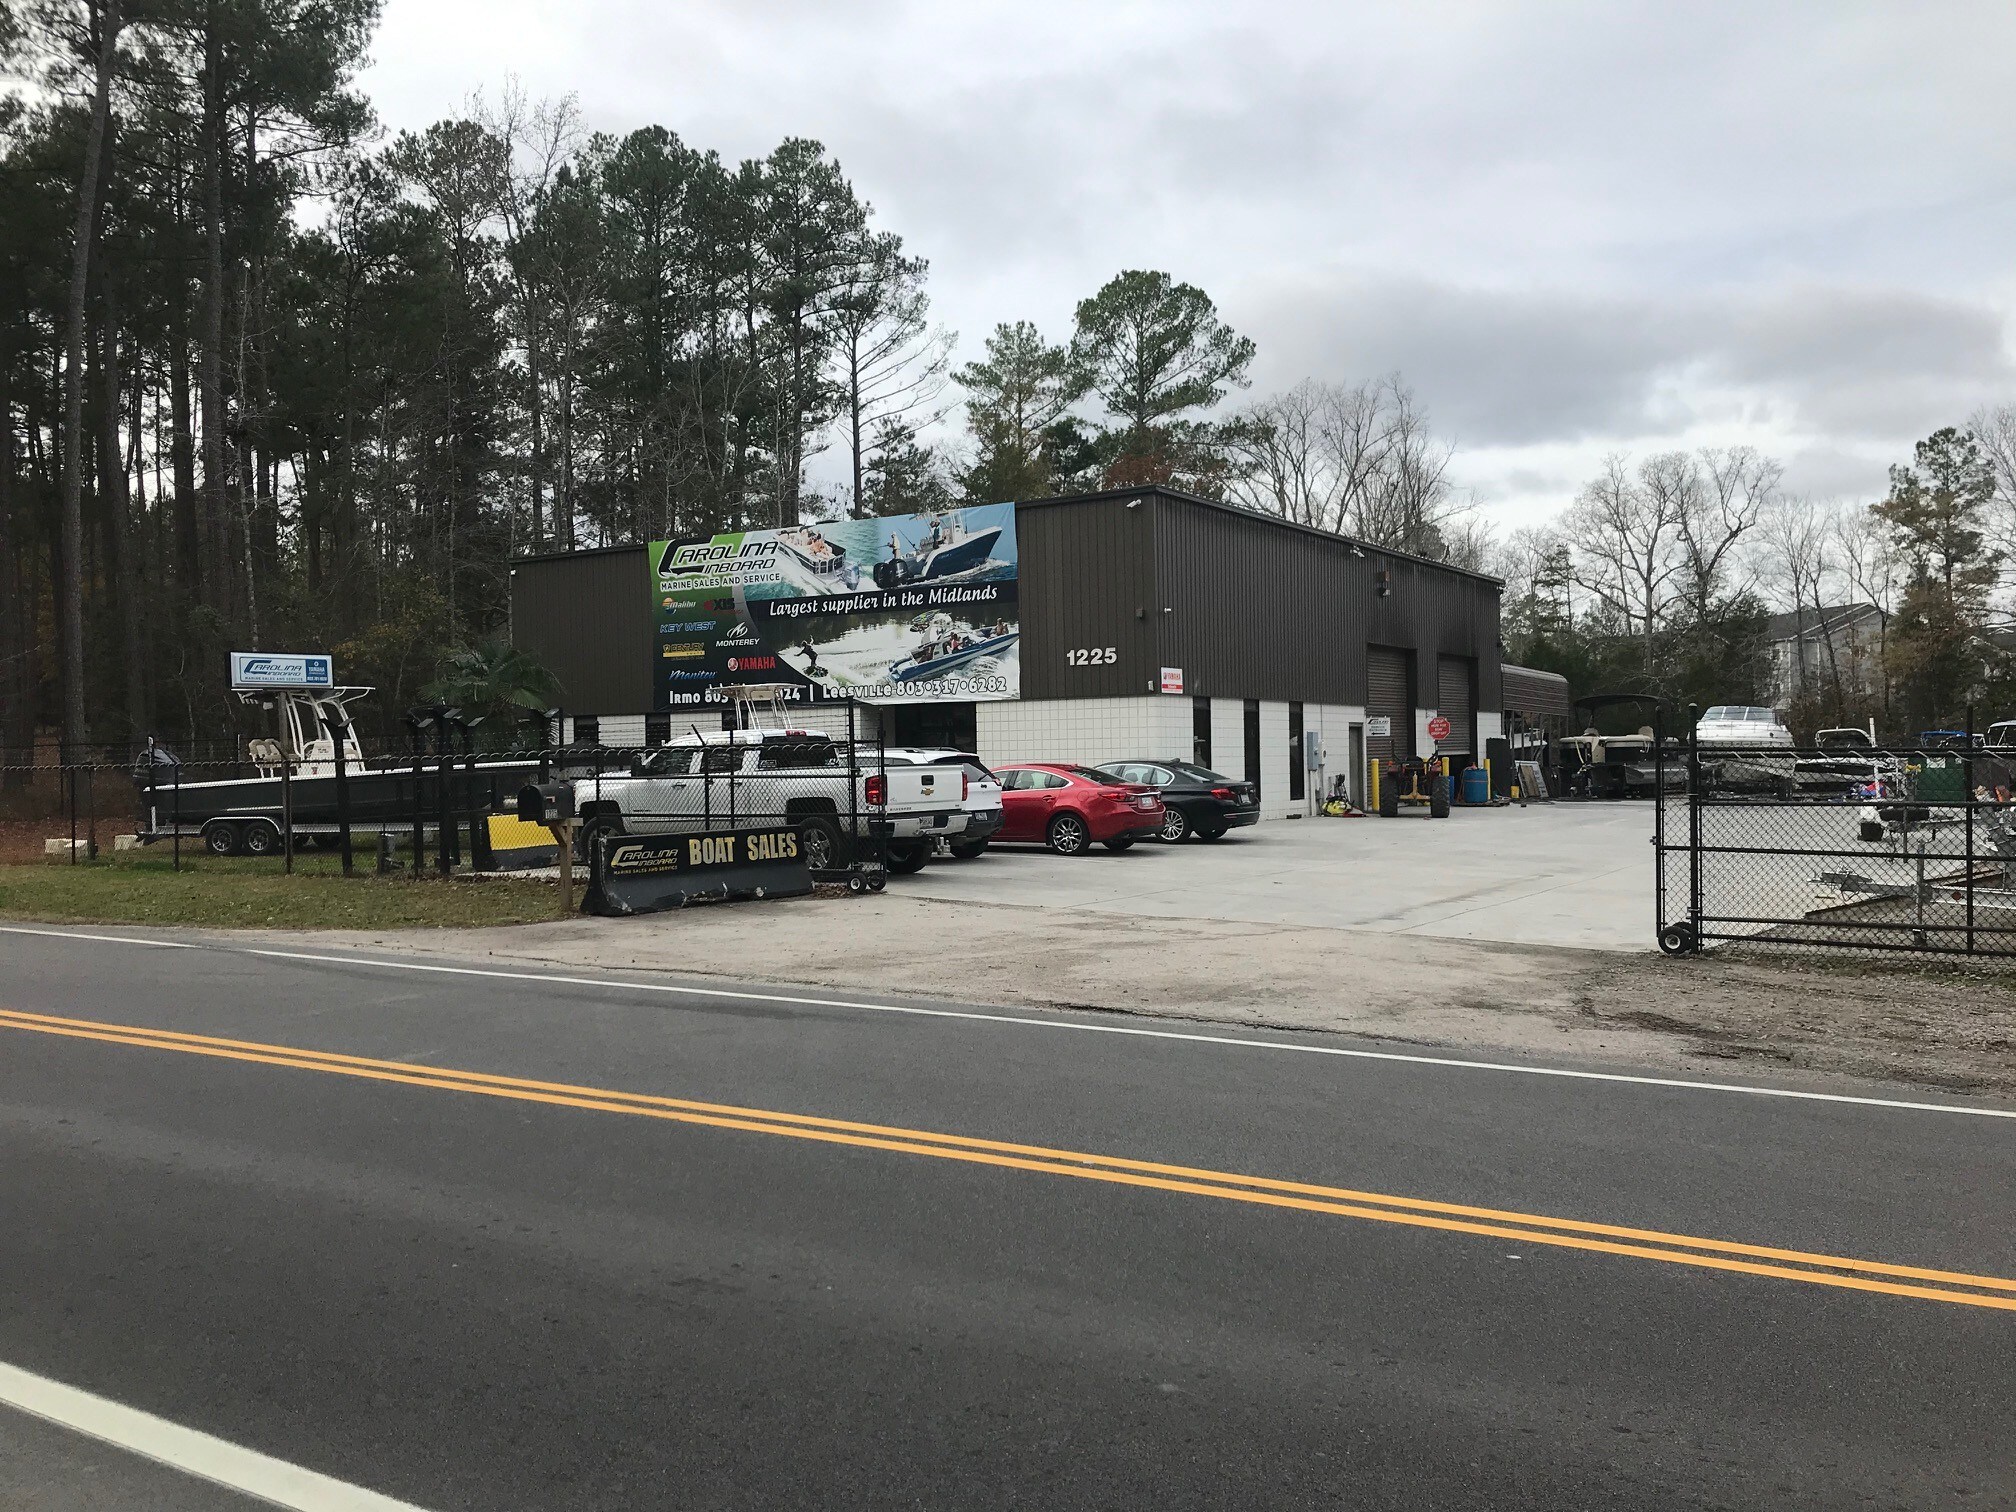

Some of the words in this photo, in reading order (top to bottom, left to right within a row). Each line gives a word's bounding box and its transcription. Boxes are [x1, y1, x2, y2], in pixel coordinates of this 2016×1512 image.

[658, 535, 779, 576] CAROLINA
[703, 559, 776, 574] INBOARD
[661, 580, 692, 591] MARINE
[694, 578, 720, 588] SALES
[722, 576, 741, 585] AND
[743, 572, 780, 583] SERVICE
[769, 600, 819, 618] Largest
[821, 594, 879, 615] supplier
[882, 592, 897, 607] in
[901, 591, 924, 606] the
[928, 584, 998, 604] Midlands
[659, 622, 684, 634] KEY
[684, 620, 717, 632] WEST
[715, 638, 760, 648] MONTEREY
[738, 657, 776, 670] YAMAHA
[1066, 647, 1118, 666] 1225
[243, 659, 303, 675] CAROLINA
[610, 844, 679, 868] CAROLINA
[688, 836, 736, 866] BOAT
[746, 832, 798, 861] SALES
[637, 857, 678, 867] INBOARD
